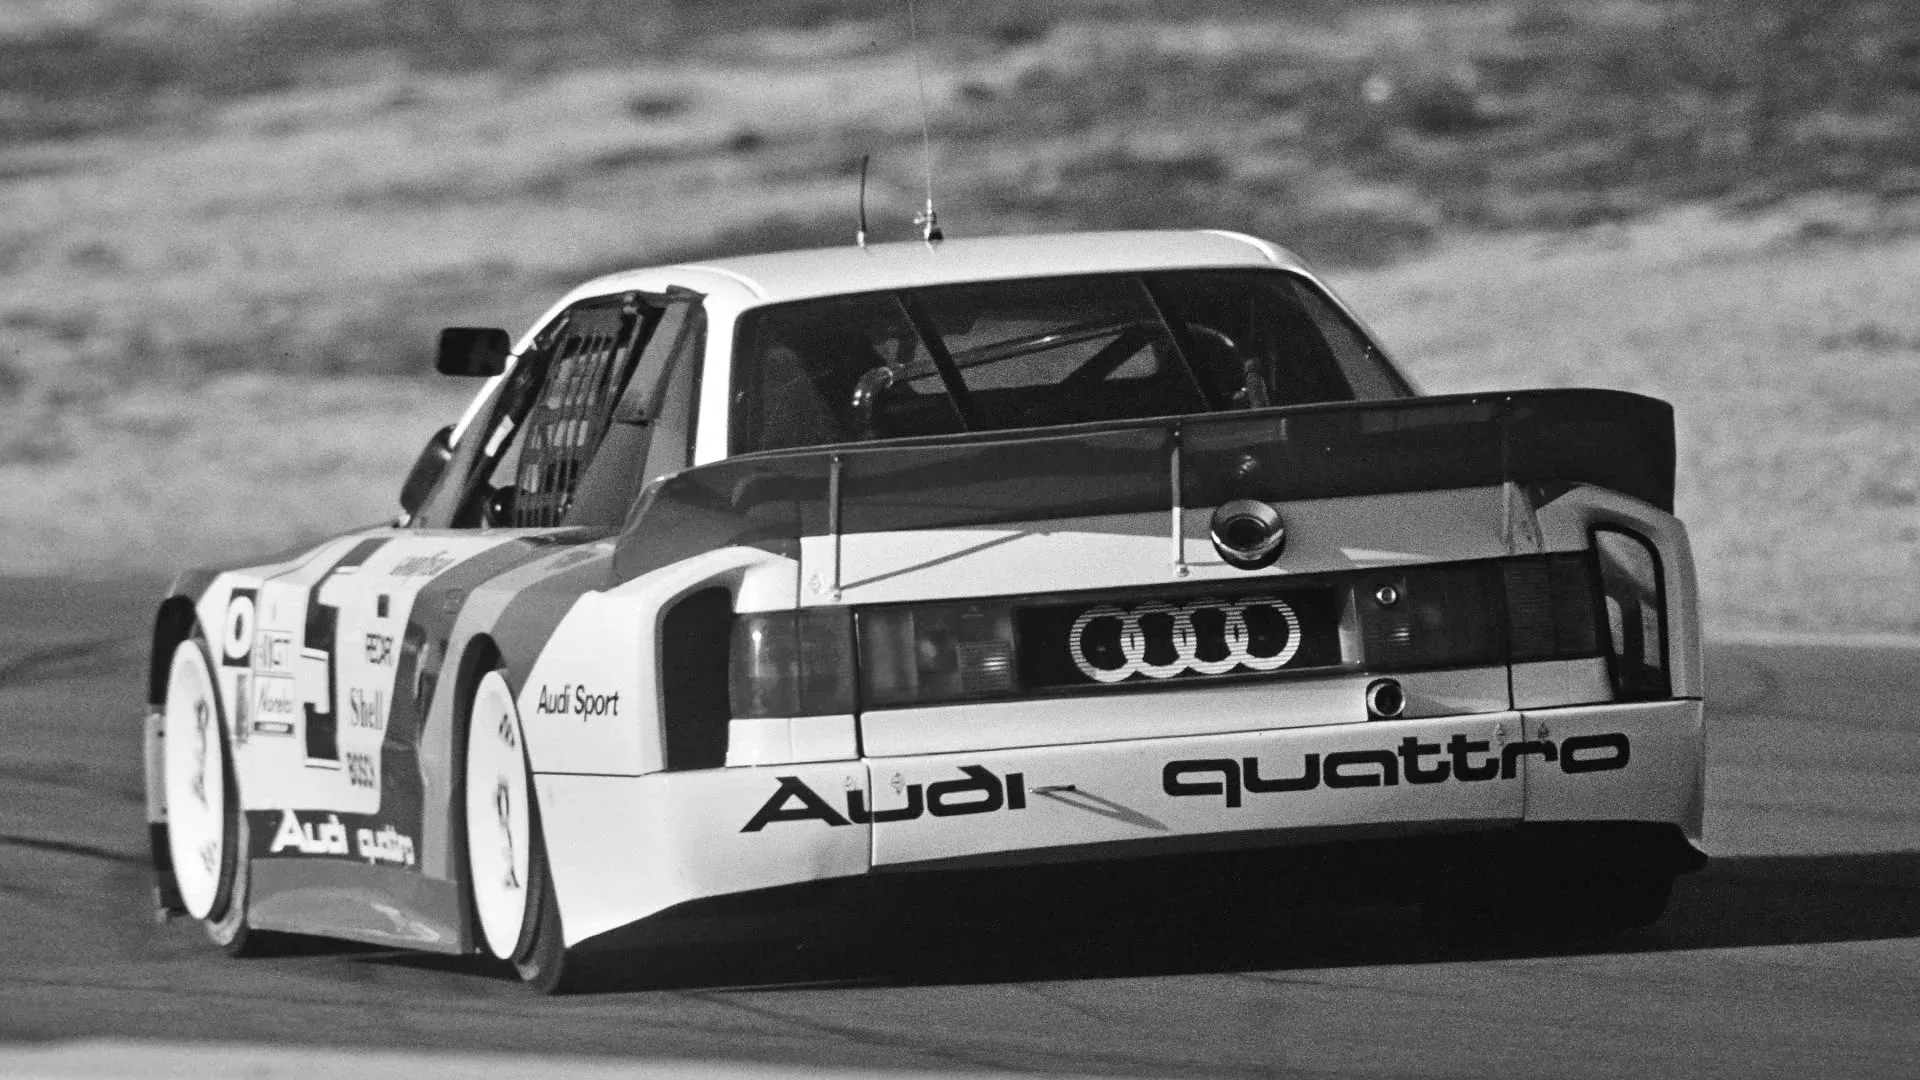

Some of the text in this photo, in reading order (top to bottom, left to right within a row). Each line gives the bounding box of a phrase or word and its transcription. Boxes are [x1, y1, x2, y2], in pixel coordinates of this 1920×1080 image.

[350, 687, 383, 731] Shell
[537, 684, 620, 722] Audi Sport
[739, 732, 1631, 833] Audi quattro
